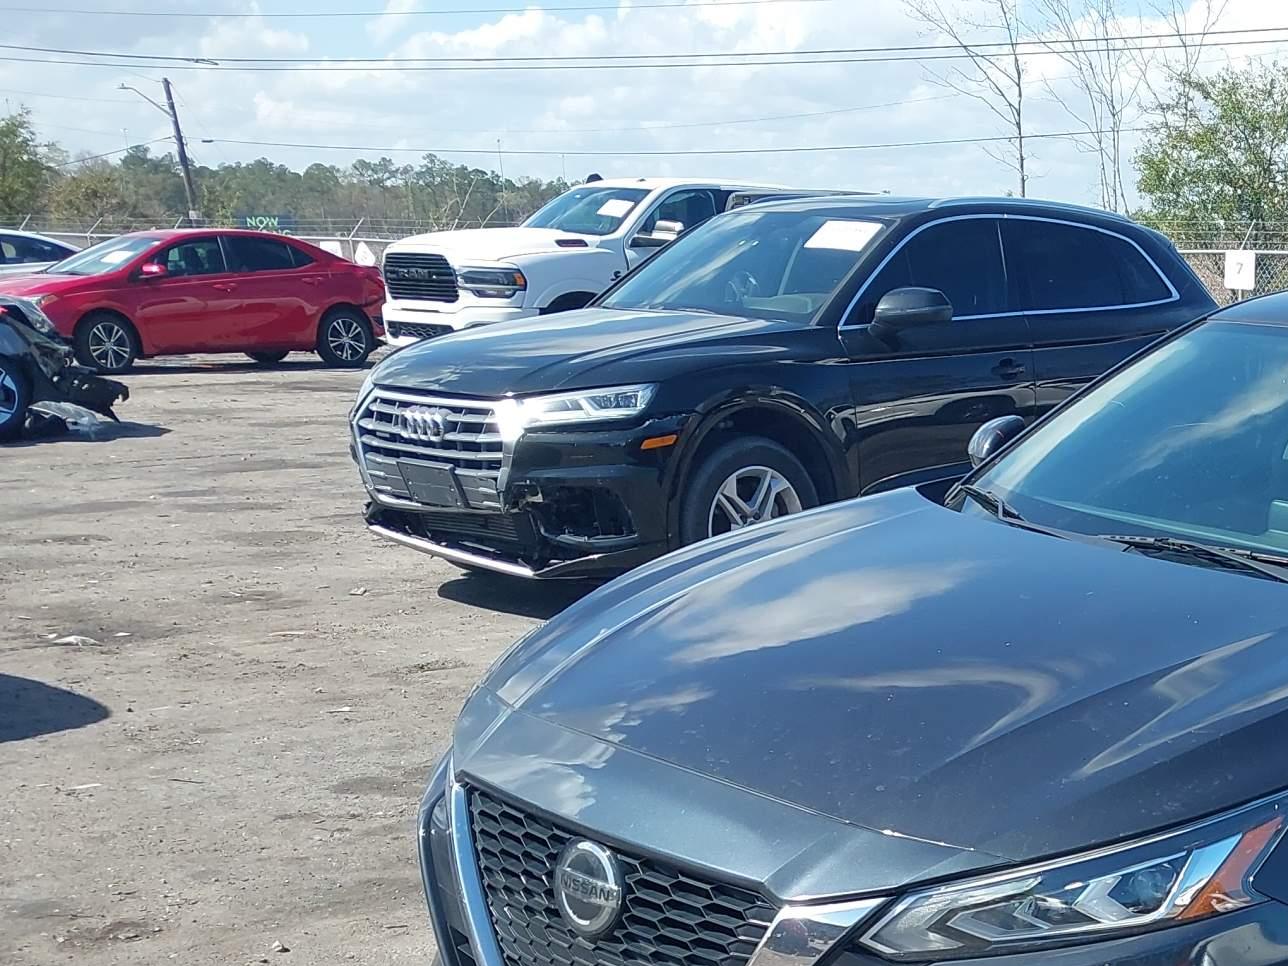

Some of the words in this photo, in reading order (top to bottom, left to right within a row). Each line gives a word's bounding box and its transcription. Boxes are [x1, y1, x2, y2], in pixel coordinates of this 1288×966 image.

[246, 216, 279, 230] NOW
[1235, 261, 1244, 275] 7
[560, 873, 611, 903] NISSAN
